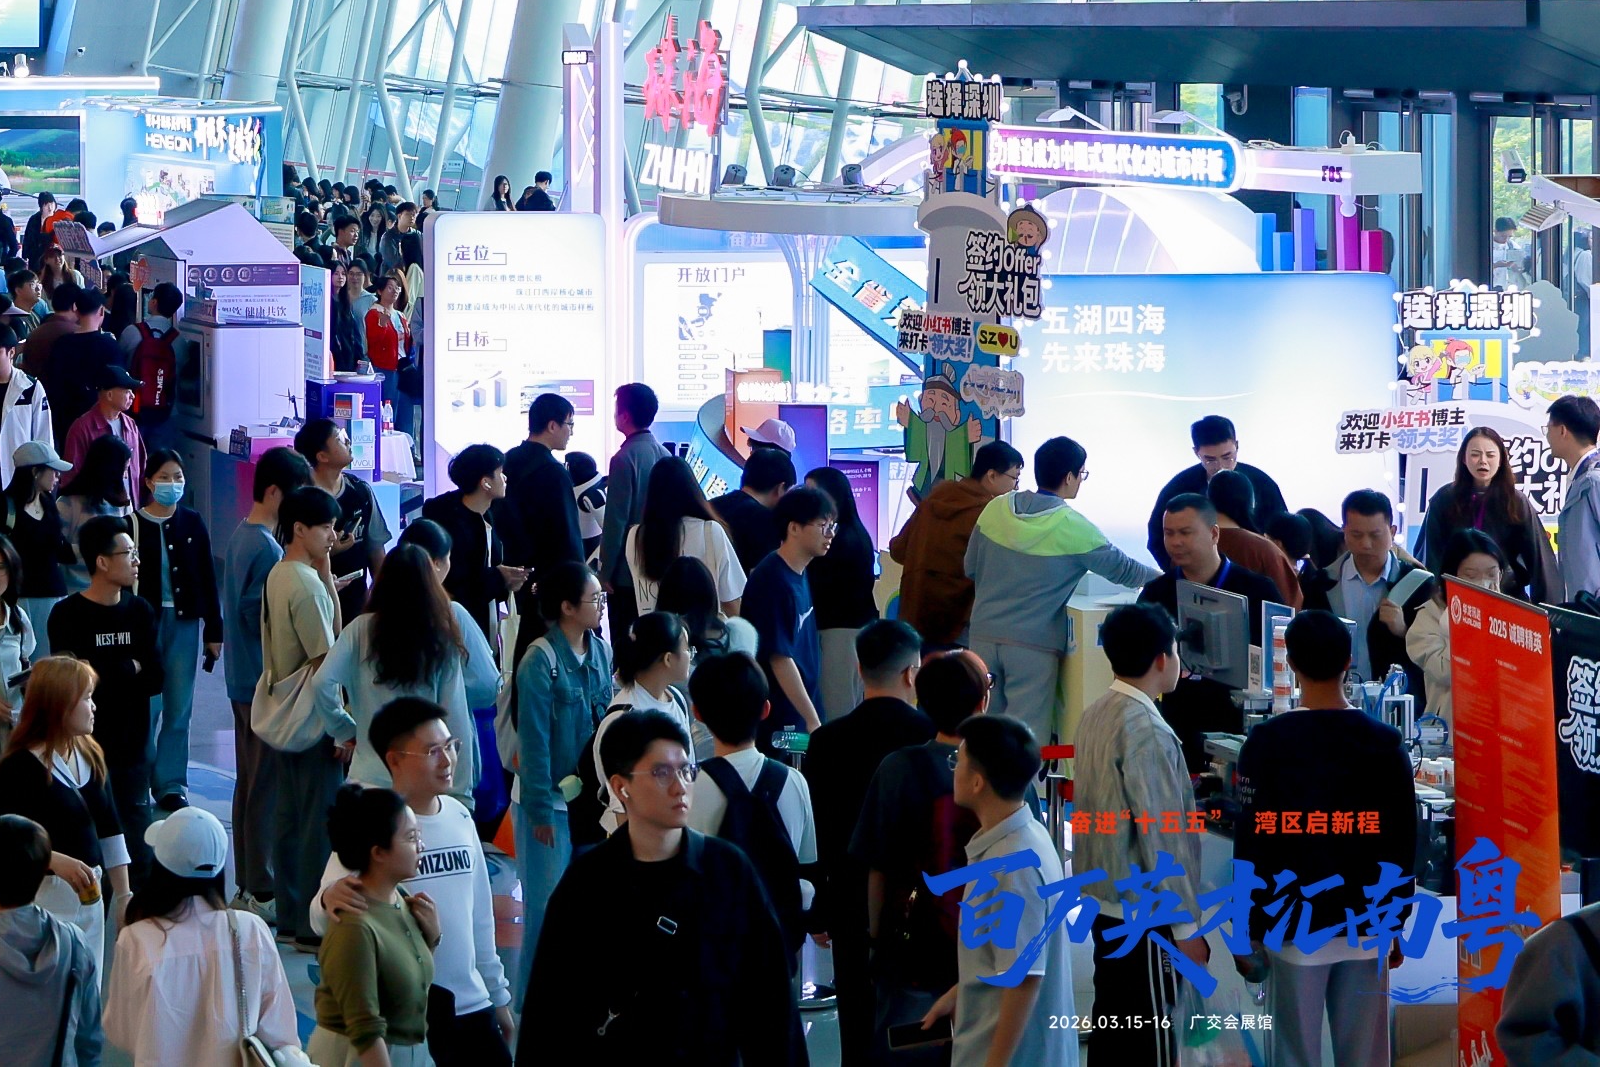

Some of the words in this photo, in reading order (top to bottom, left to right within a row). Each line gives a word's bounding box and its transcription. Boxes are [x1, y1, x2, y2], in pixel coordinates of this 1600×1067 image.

[926, 81, 1000, 120] 选择深圳
[639, 143, 714, 195] ZHUHAI
[454, 244, 490, 262] 定位
[677, 267, 746, 284] 开放门户
[955, 272, 1042, 319] 领大礼包
[1403, 292, 1533, 330] 选择深圳
[899, 313, 972, 337] 欢迎小红书博主
[1041, 304, 1166, 336] 五湖四海
[455, 331, 490, 347] 目标
[1041, 342, 1166, 374] 先来珠海
[1341, 406, 1466, 430] 欢迎小红书博主
[1489, 616, 1507, 639] 2025
[1508, 622, 1543, 655] 诚聘精英
[1570, 661, 1600, 714] 签
[419, 849, 471, 875] MIZUNO
